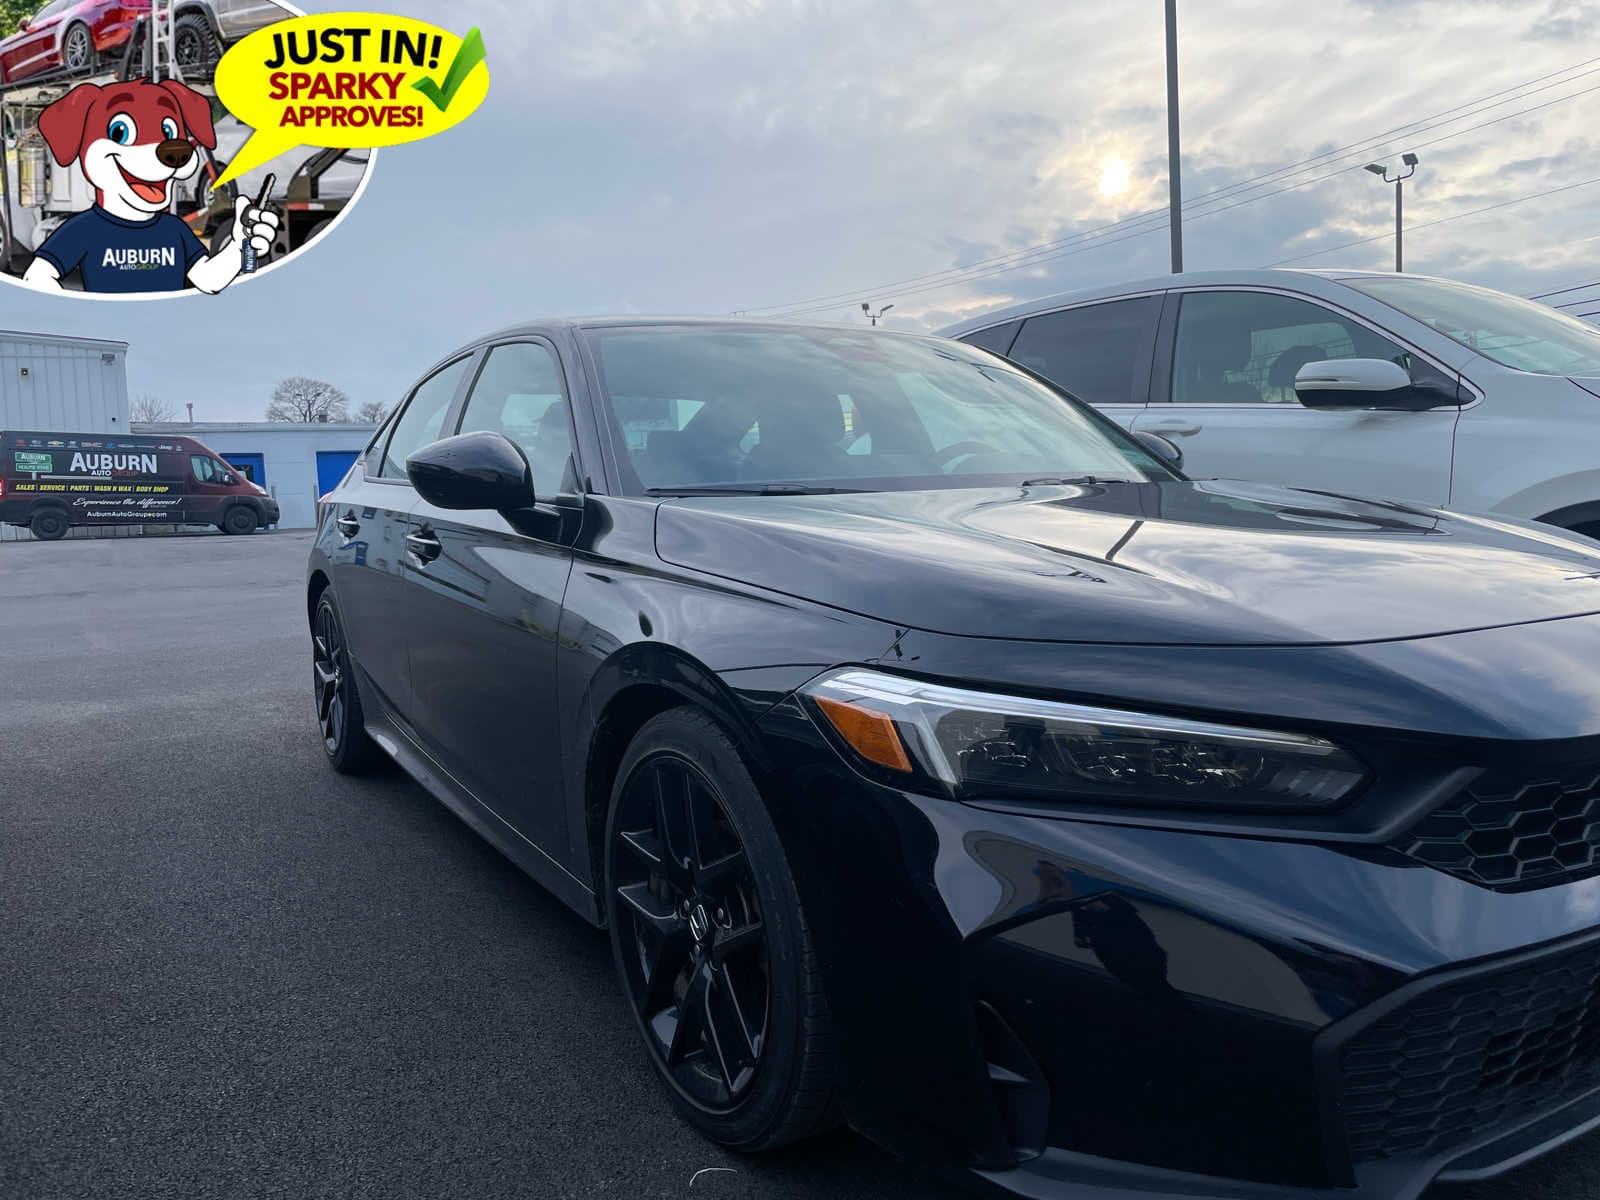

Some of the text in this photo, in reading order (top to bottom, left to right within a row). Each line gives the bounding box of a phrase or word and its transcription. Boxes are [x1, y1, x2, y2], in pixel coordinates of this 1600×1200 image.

[69, 452, 157, 474] AUBURN
[73, 498, 122, 508] Experience
[86, 511, 167, 519] AuburnAutoGroup.com
